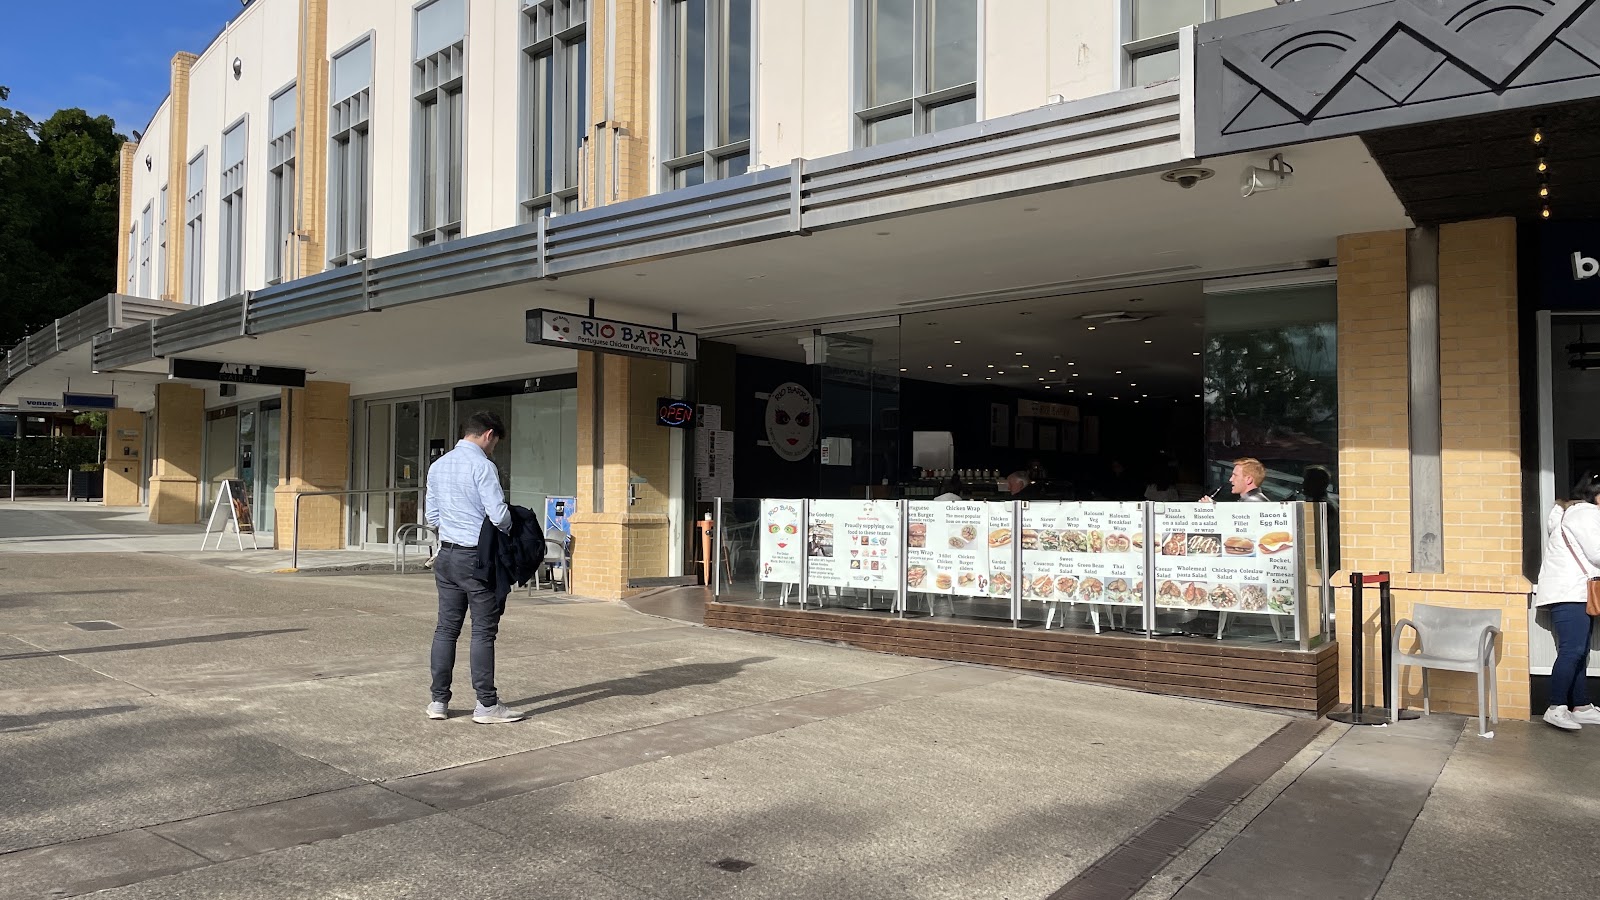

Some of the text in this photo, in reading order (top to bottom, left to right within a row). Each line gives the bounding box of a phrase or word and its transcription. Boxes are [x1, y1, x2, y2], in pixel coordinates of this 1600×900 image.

[1571, 251, 1600, 281] b
[581, 320, 686, 350] RIO BARRA
[577, 336, 609, 346] Portuguese
[609, 340, 630, 349] Chicken
[631, 343, 651, 352] Burgers,
[652, 346, 668, 355] Wraps
[673, 349, 689, 357] Salads
[774, 386, 810, 404] RIO BARRA
[659, 405, 692, 421] OPEN
[768, 506, 779, 517] RIO
